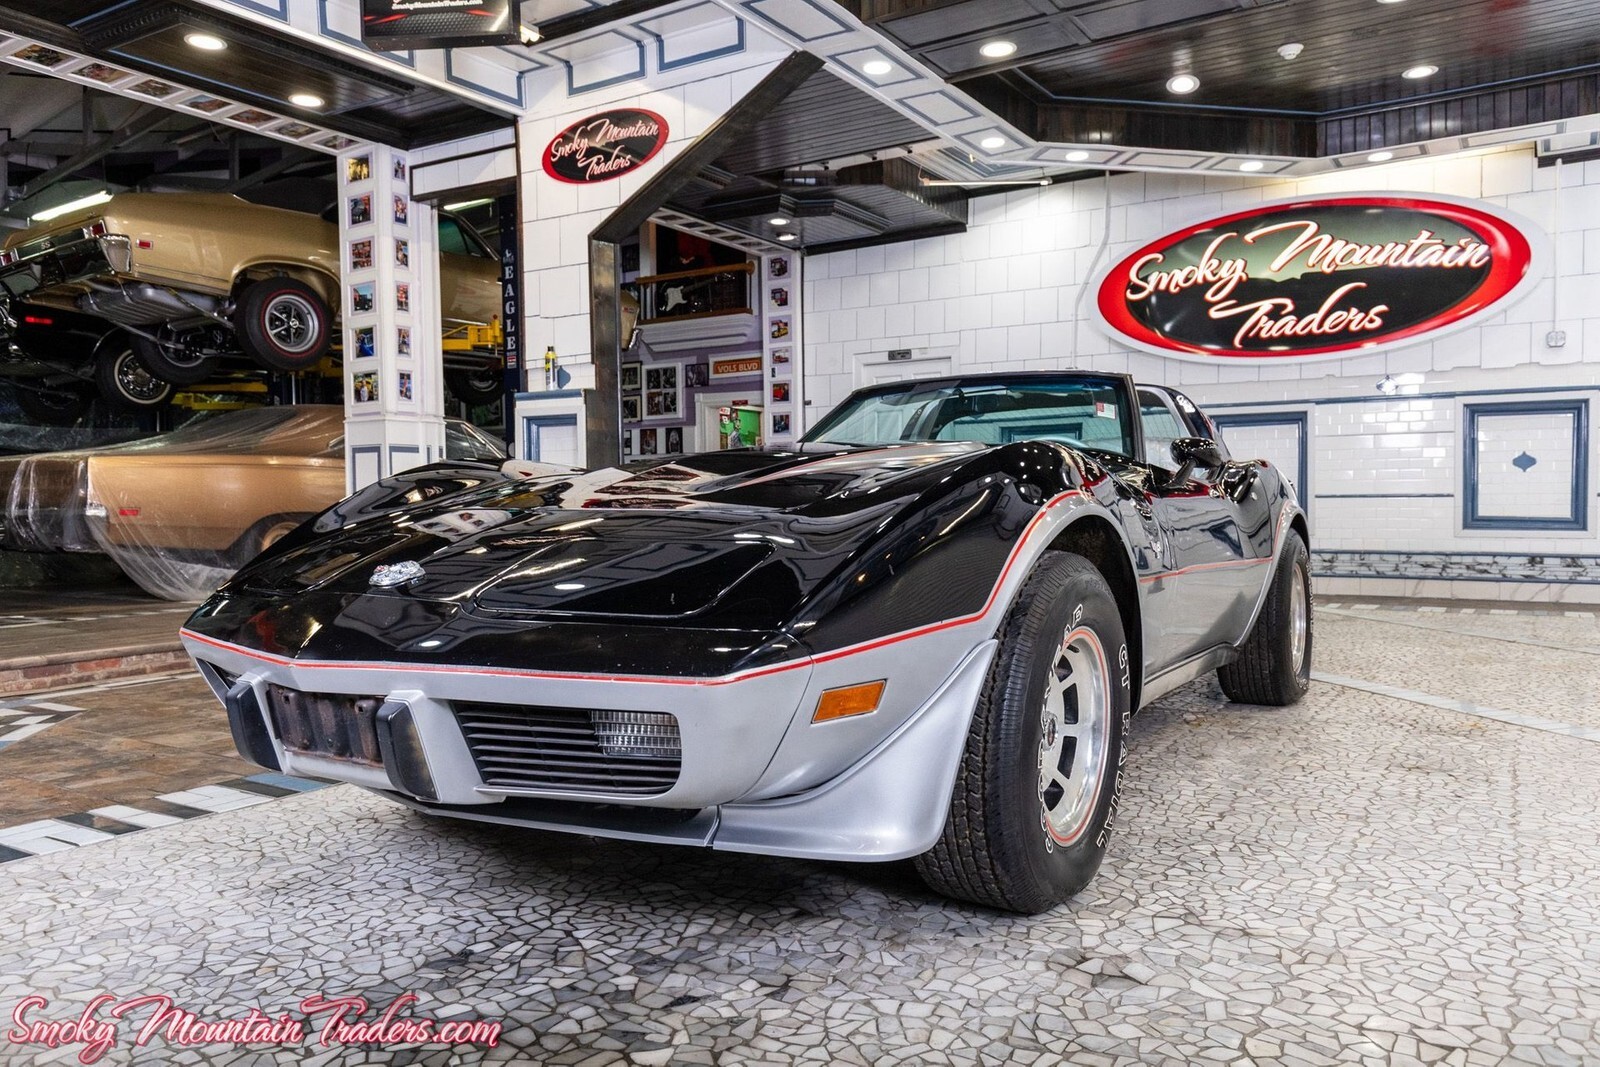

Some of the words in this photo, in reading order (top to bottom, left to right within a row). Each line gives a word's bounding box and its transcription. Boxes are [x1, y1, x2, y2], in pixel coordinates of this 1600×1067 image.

[551, 126, 590, 162] Smoky
[587, 118, 659, 142] Mountain
[577, 145, 632, 180] Traders
[1126, 232, 1248, 303] Smoky
[1244, 220, 1493, 275] Mountain
[504, 265, 516, 350] EAGLE
[1208, 282, 1390, 348] Traders
[717, 364, 737, 373] VOLS
[738, 362, 758, 372] BLVD
